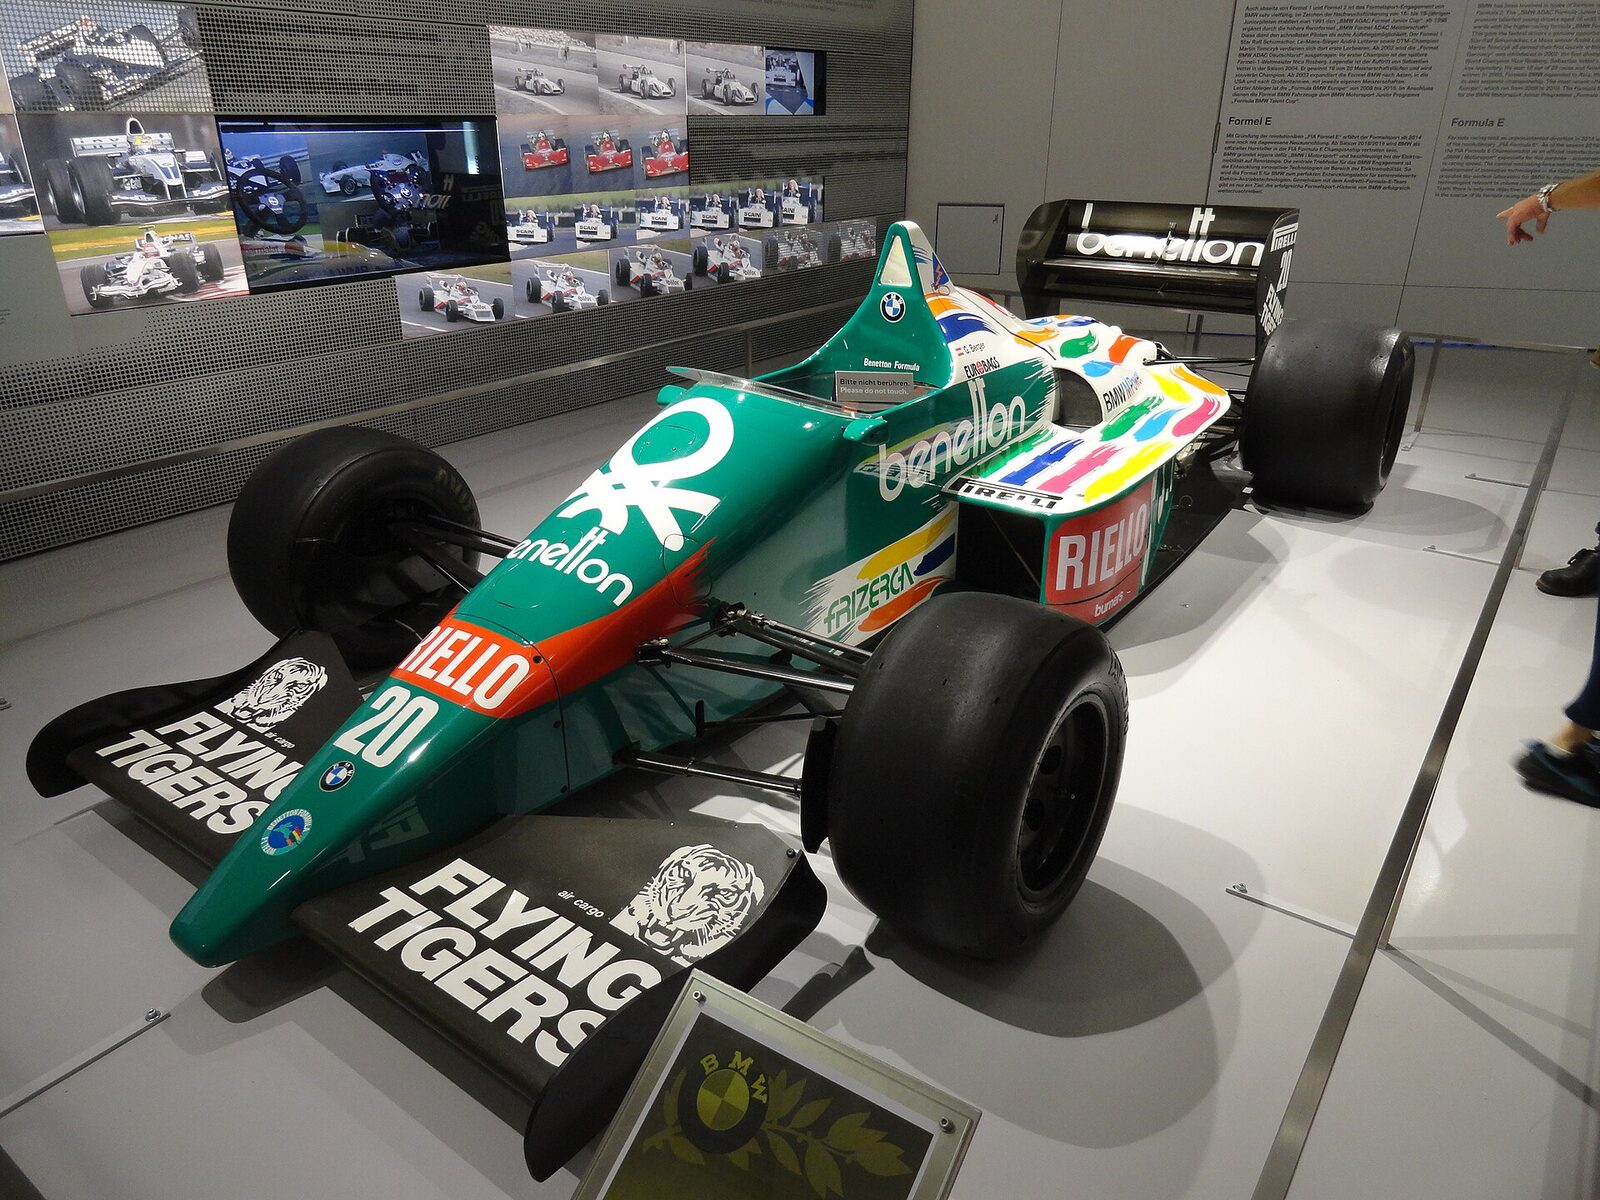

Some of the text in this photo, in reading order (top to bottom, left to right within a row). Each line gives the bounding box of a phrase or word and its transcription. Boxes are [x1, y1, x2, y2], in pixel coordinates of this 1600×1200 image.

[1228, 116, 1272, 126] Formel E
[1450, 117, 1505, 127] Formula E
[1075, 202, 1264, 267] benetton
[1270, 223, 1299, 252] PIRELLI
[1276, 249, 1293, 293] 20
[863, 357, 920, 371] Benetton Formula
[969, 342, 985, 352] Berger
[1102, 383, 1126, 412] BMW
[878, 377, 1025, 502] benetton
[507, 526, 634, 607] enetton
[1055, 502, 1148, 592] RIELLO
[1094, 591, 1124, 618] burners
[398, 625, 531, 710] RIELLO
[274, 737, 296, 749] cargo
[333, 685, 440, 768] 20
[96, 729, 271, 835] TIGERS
[557, 890, 605, 918] air cargo
[408, 858, 662, 1013] FLYING
[347, 886, 607, 1067] TIGERS
